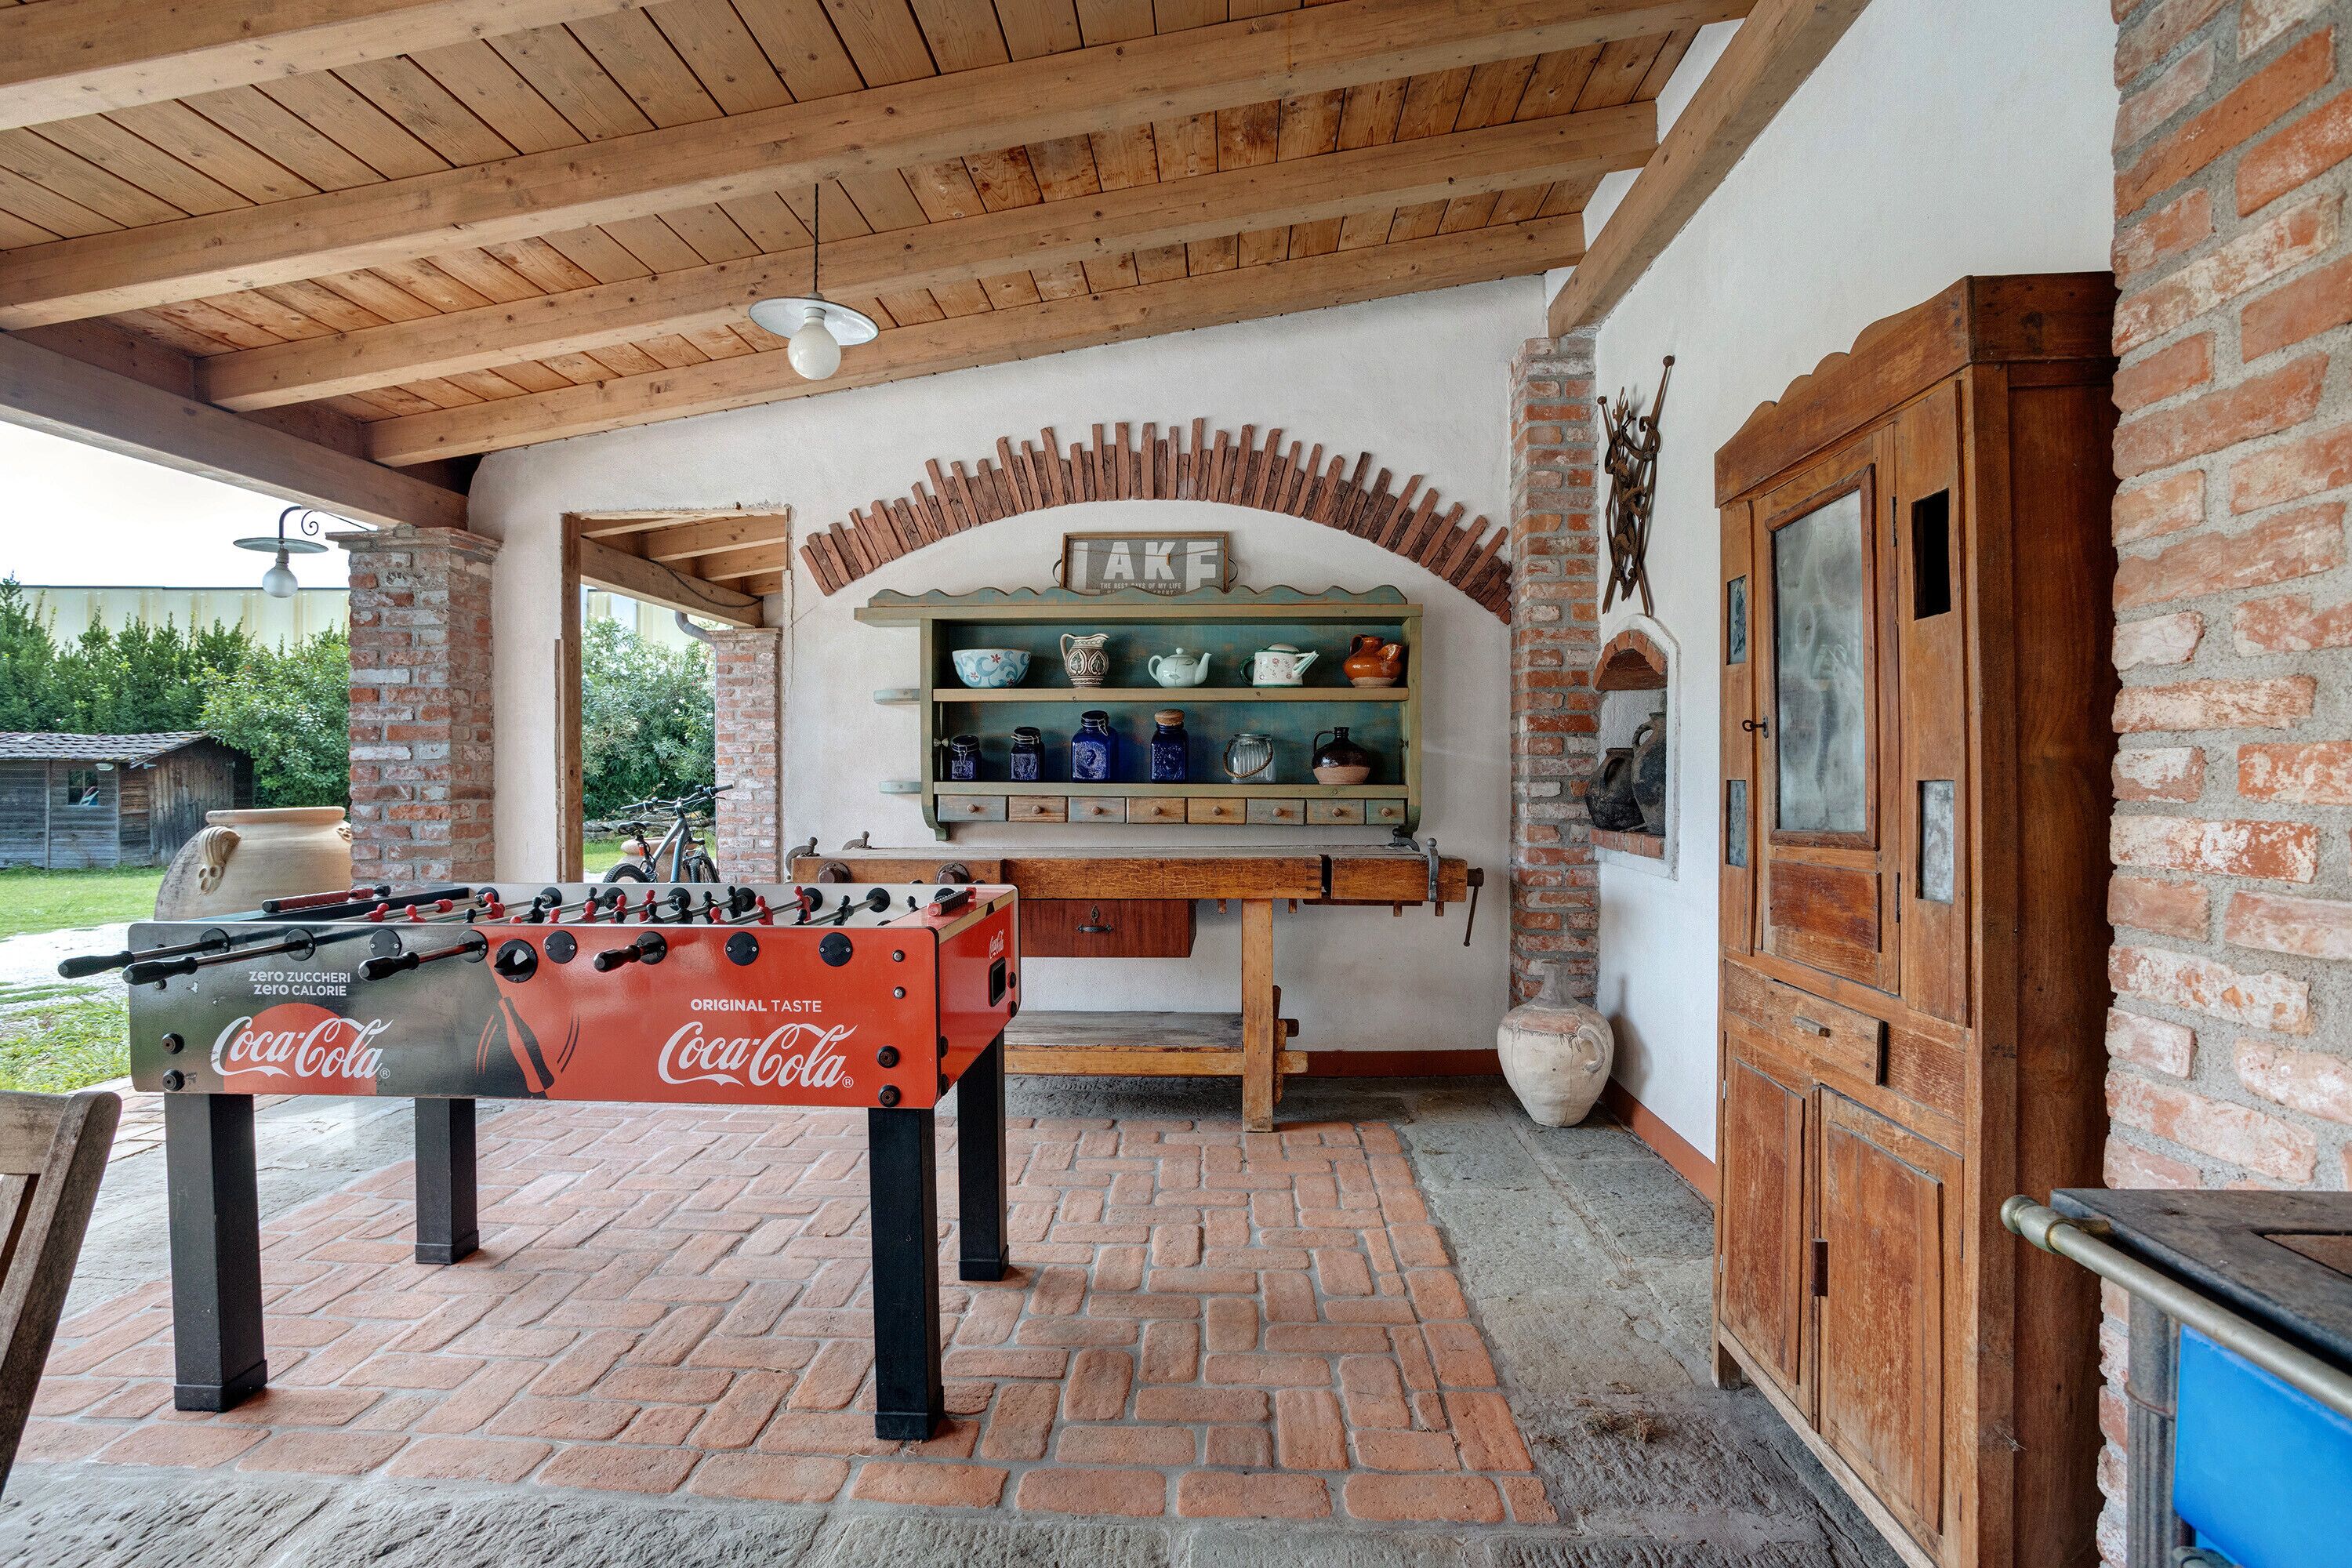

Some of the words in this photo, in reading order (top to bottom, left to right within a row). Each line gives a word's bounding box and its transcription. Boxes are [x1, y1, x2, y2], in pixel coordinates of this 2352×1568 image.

[249, 971, 285, 982] zero
[286, 971, 351, 983] ZUCCHERI
[253, 984, 289, 995] zero
[292, 985, 347, 996] CALORIE
[690, 998, 768, 1012] ORIGINAL
[771, 1000, 822, 1013] TASTE
[210, 1015, 394, 1079] Coca-Cola
[658, 1021, 858, 1088] Coca-Cola
